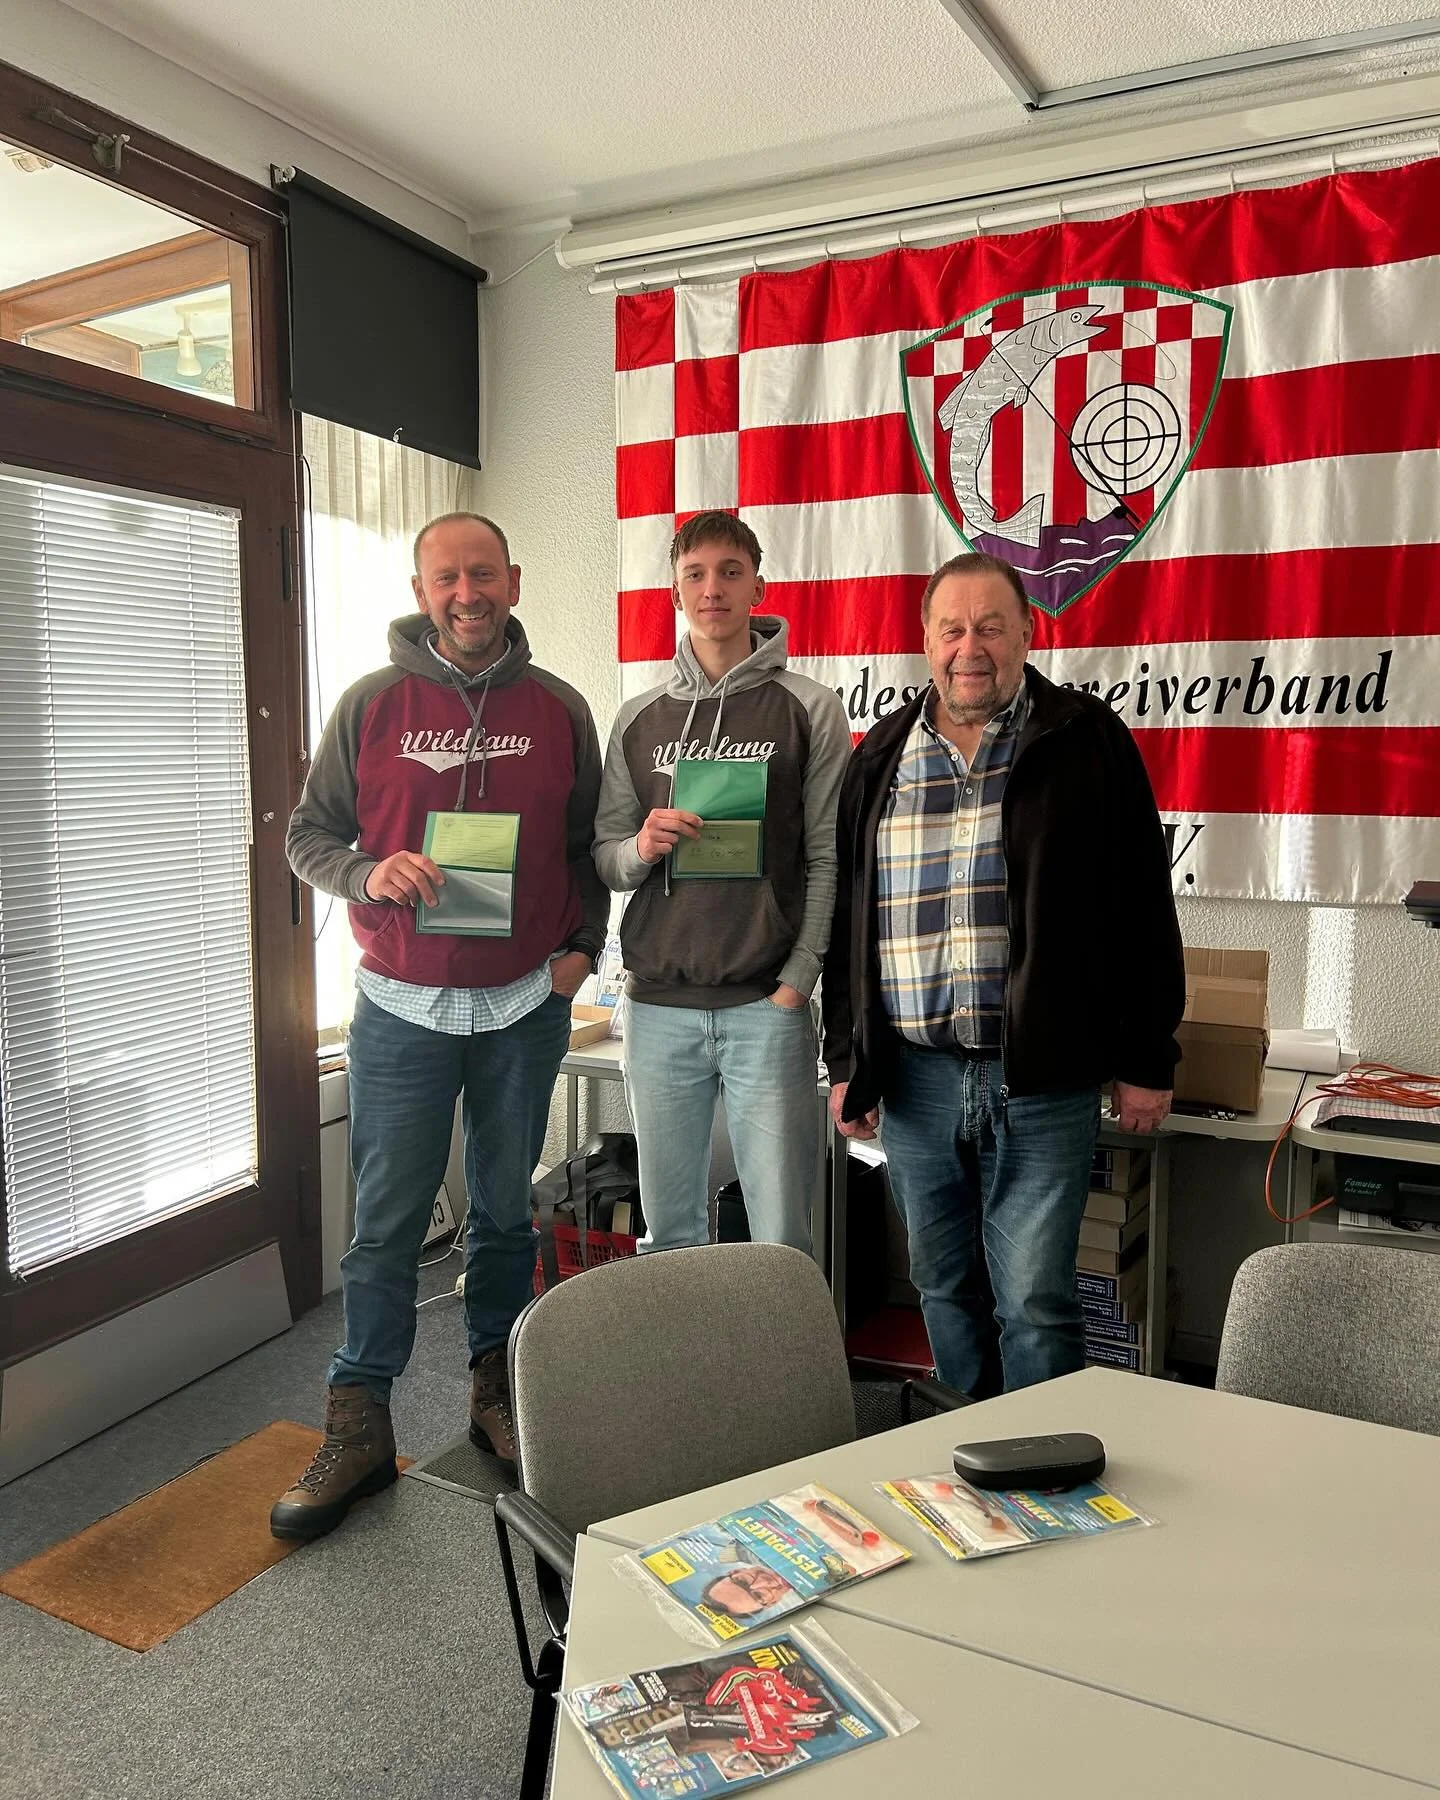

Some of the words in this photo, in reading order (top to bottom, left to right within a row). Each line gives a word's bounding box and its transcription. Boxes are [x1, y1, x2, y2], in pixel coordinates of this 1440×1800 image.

[400, 727, 535, 757] Wildfang
[652, 736, 778, 767] Wildfang
[734, 1515, 830, 1579] TESTPAKET
